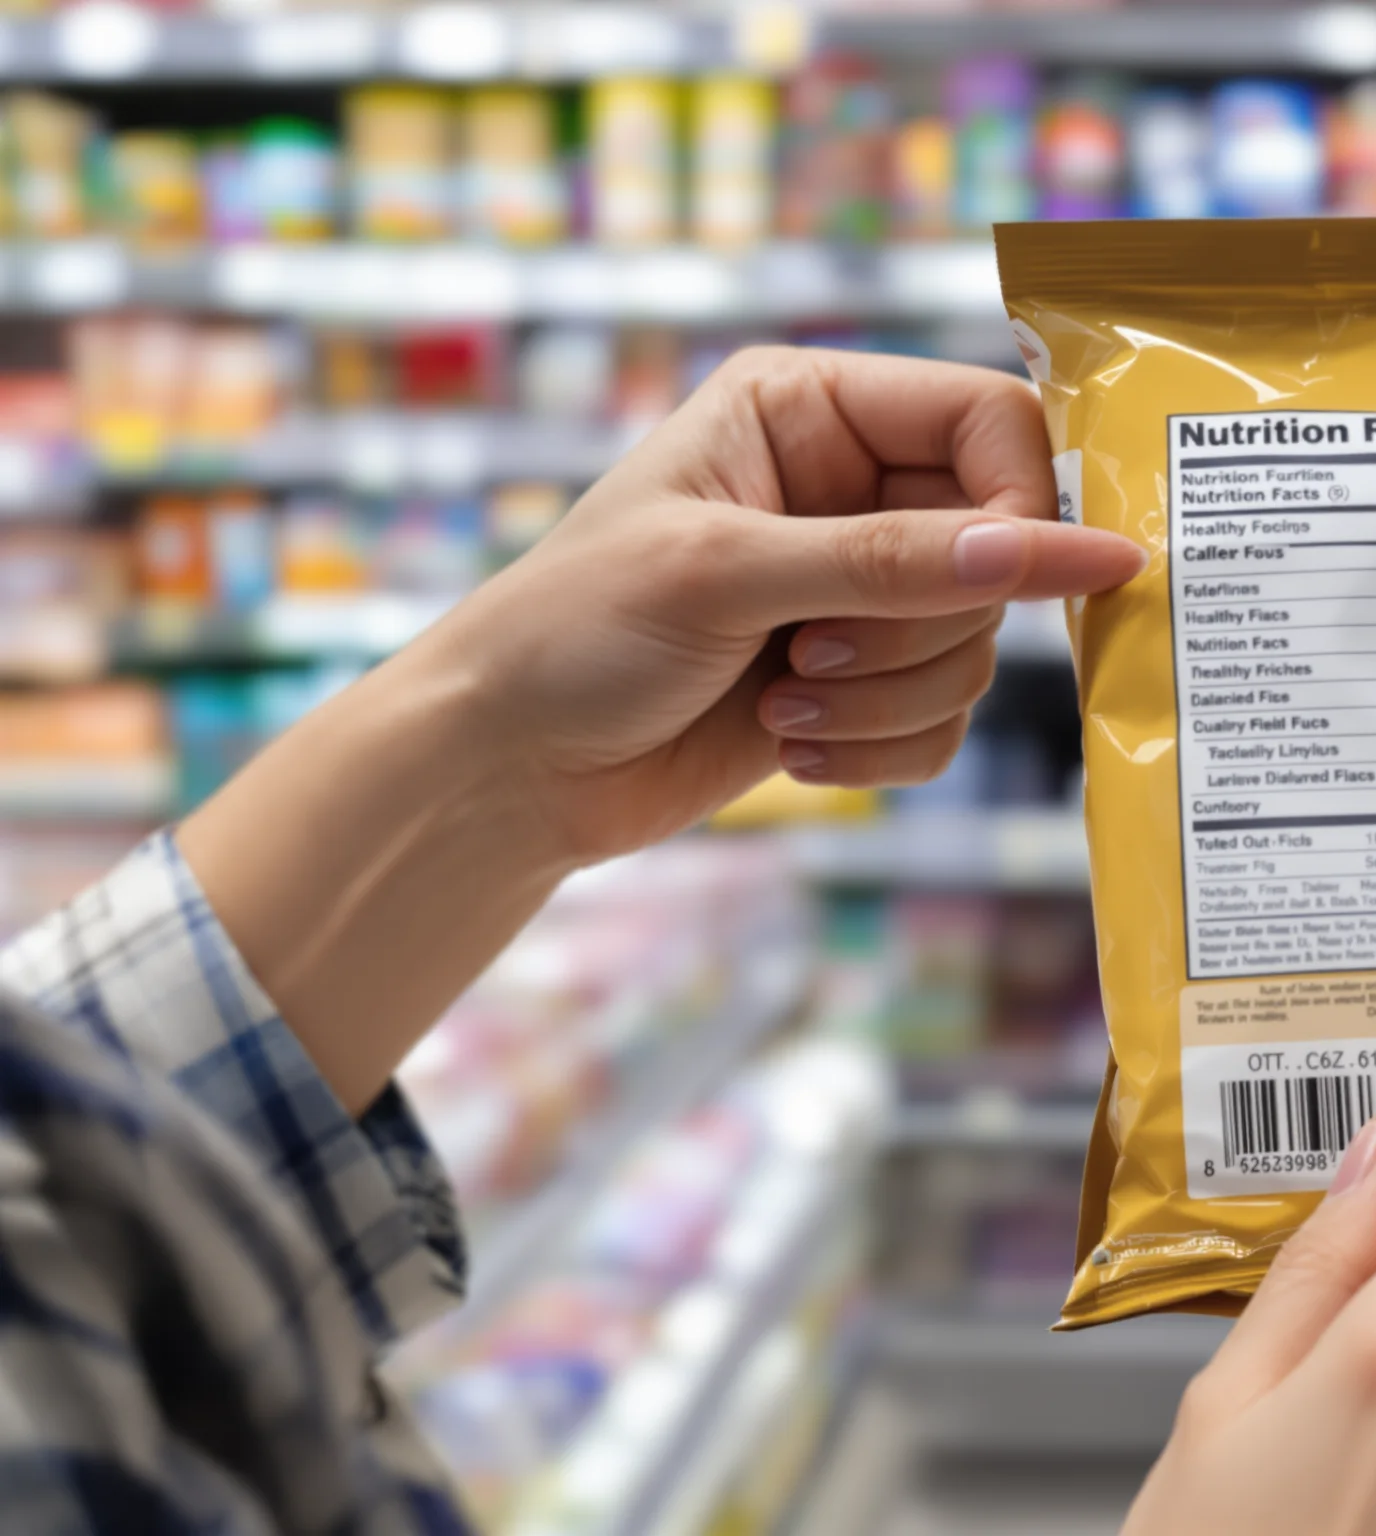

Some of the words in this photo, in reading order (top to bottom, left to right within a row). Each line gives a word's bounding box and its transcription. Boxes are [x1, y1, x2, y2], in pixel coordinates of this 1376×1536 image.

[1180, 418, 1349, 447] Nutrition
[1182, 470, 1259, 486] Nutrition
[1182, 488, 1265, 504] Nutrition
[1272, 487, 1320, 501] Facts
[1183, 520, 1246, 537] Healthy
[1204, 1159, 1215, 1178] 8
